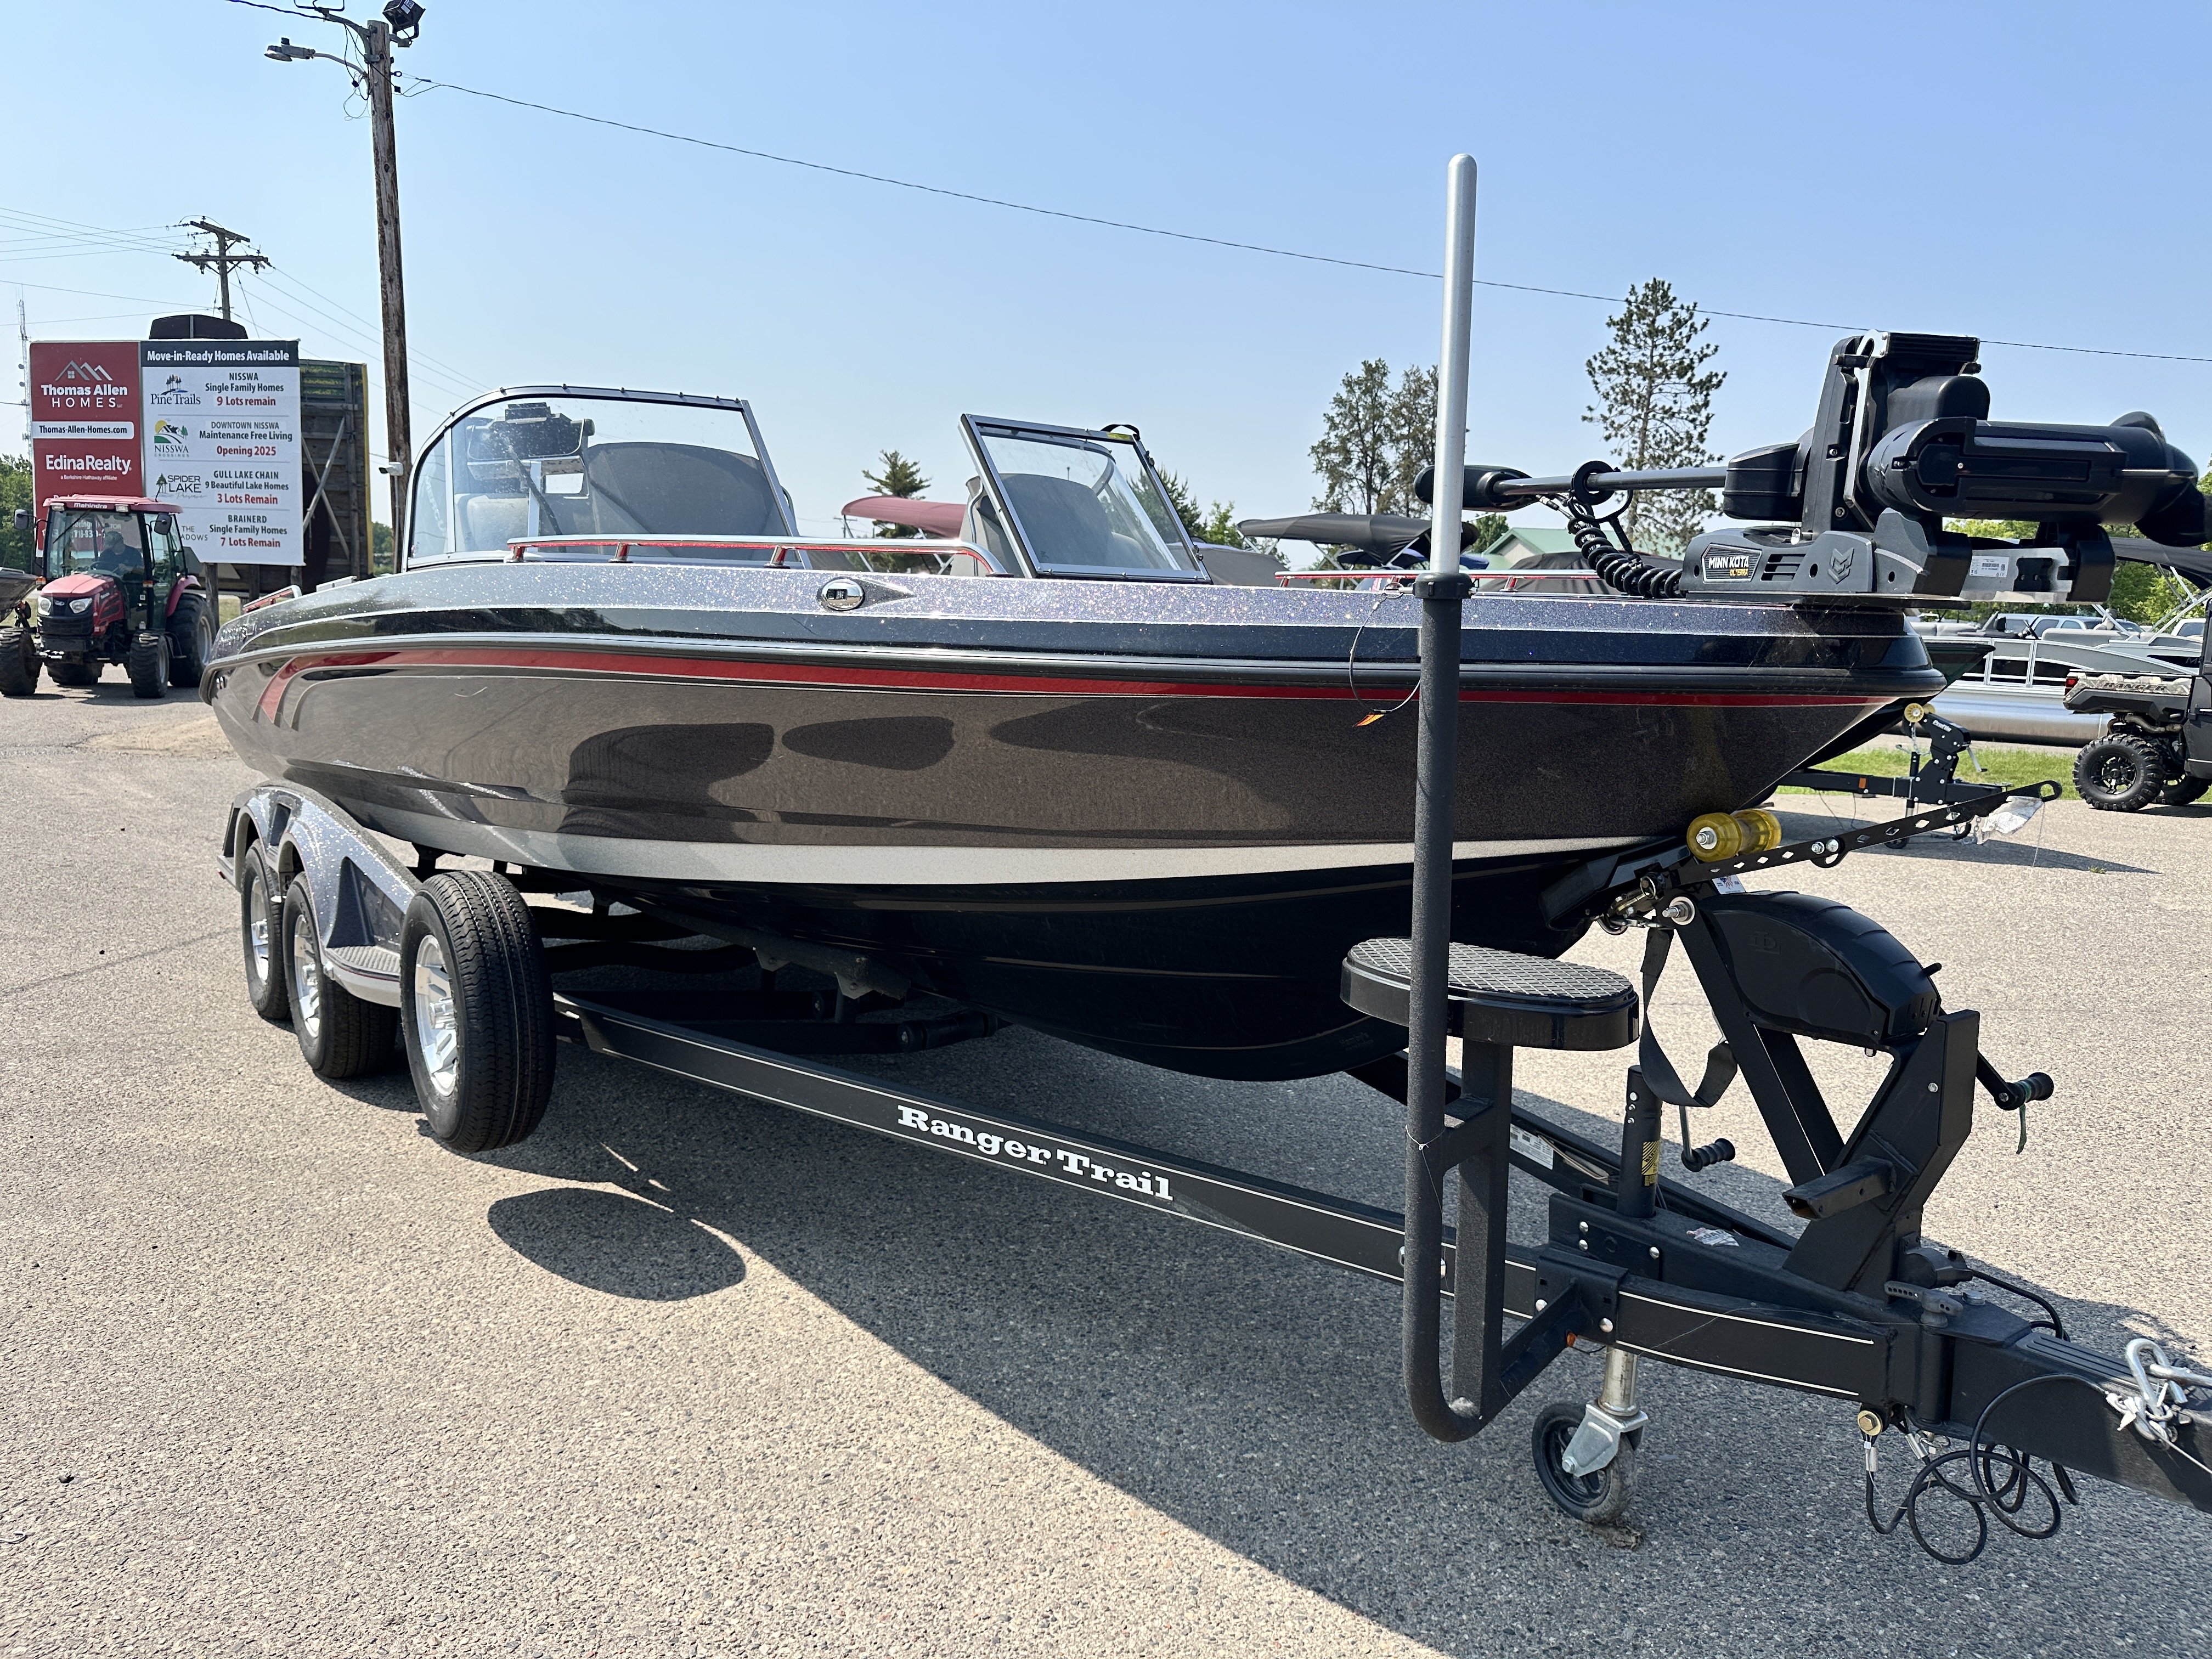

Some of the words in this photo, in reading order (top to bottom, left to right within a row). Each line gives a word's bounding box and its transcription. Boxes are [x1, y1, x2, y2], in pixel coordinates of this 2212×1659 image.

[147, 350, 213, 363] Move-in-Ready
[215, 350, 246, 361] Homes
[247, 350, 290, 361] Available
[229, 373, 259, 381] NISSWA
[41, 384, 91, 396] Thomas
[93, 384, 128, 396] Allen
[205, 383, 229, 393] Single
[230, 383, 256, 393] Family
[257, 383, 284, 392] Homes
[52, 397, 116, 408] HOMES
[150, 393, 172, 405] Pine
[172, 393, 201, 405] Trails
[217, 396, 223, 406] 9
[226, 396, 243, 405] Lots
[245, 396, 276, 406] remain
[39, 425, 127, 434] Thomas-Allen-Homes.com
[199, 430, 249, 439] Maintenance
[251, 431, 267, 439] Free
[269, 431, 292, 442] Living
[155, 444, 189, 453] NISSWA
[217, 445, 252, 458] Opening
[254, 445, 276, 456] 2025
[46, 454, 84, 471] Edina
[86, 455, 131, 475] Realty
[213, 470, 233, 478] GULL
[234, 471, 253, 479] LAKE
[255, 471, 279, 479] CHAIN
[168, 483, 201, 493] LAKE
[211, 481, 244, 489] Beautiful
[246, 482, 263, 490] Lake
[264, 482, 289, 490] Homes
[217, 493, 222, 503] 3
[224, 493, 243, 504] Lots
[245, 494, 278, 504] Remain
[228, 515, 267, 523] BRAINERD
[210, 524, 233, 535] Single
[234, 525, 259, 535] Family
[261, 526, 287, 535] Homes
[221, 537, 226, 546] 7
[229, 537, 246, 546] Lots
[248, 538, 281, 548] Remain
[1708, 556, 1729, 568] MINN
[1729, 555, 1750, 568] KOTA
[898, 1104, 1052, 1165] Ranger
[1057, 1149, 1173, 1201] Trail
